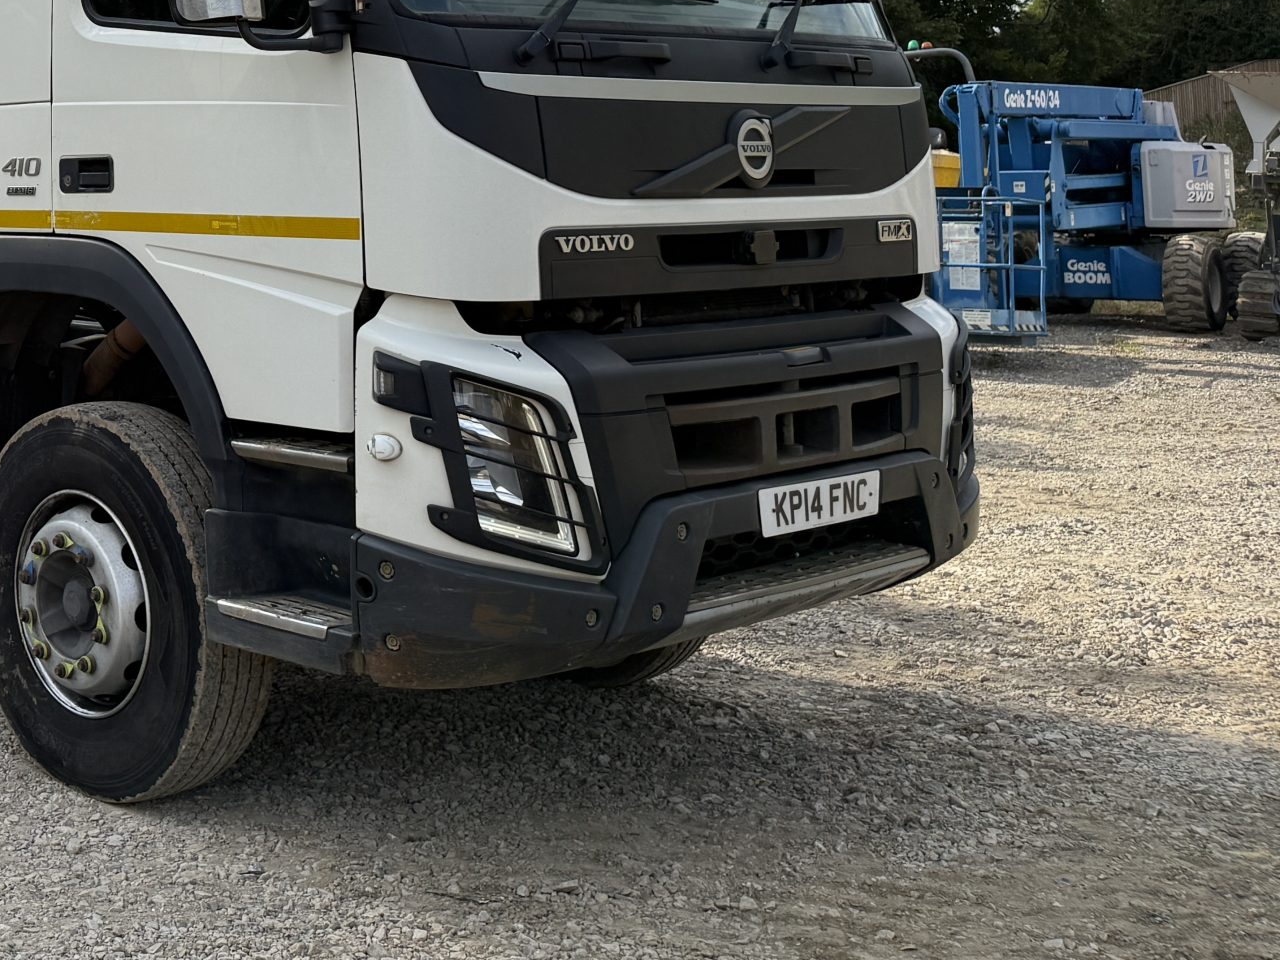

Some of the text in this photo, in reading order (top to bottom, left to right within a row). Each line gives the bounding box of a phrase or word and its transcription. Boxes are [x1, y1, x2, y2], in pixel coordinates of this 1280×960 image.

[1004, 88, 1060, 109] Genie Z-60/34
[741, 144, 772, 152] VOLVO
[1, 157, 42, 177] 410
[1185, 180, 1214, 191] Genie
[1187, 191, 1214, 202] 2WD
[881, 221, 911, 239] FMX
[555, 234, 634, 253] VOLVO
[1067, 259, 1107, 271] Genie
[1063, 272, 1112, 284] BOOM
[774, 479, 868, 527] KP14 FNC
